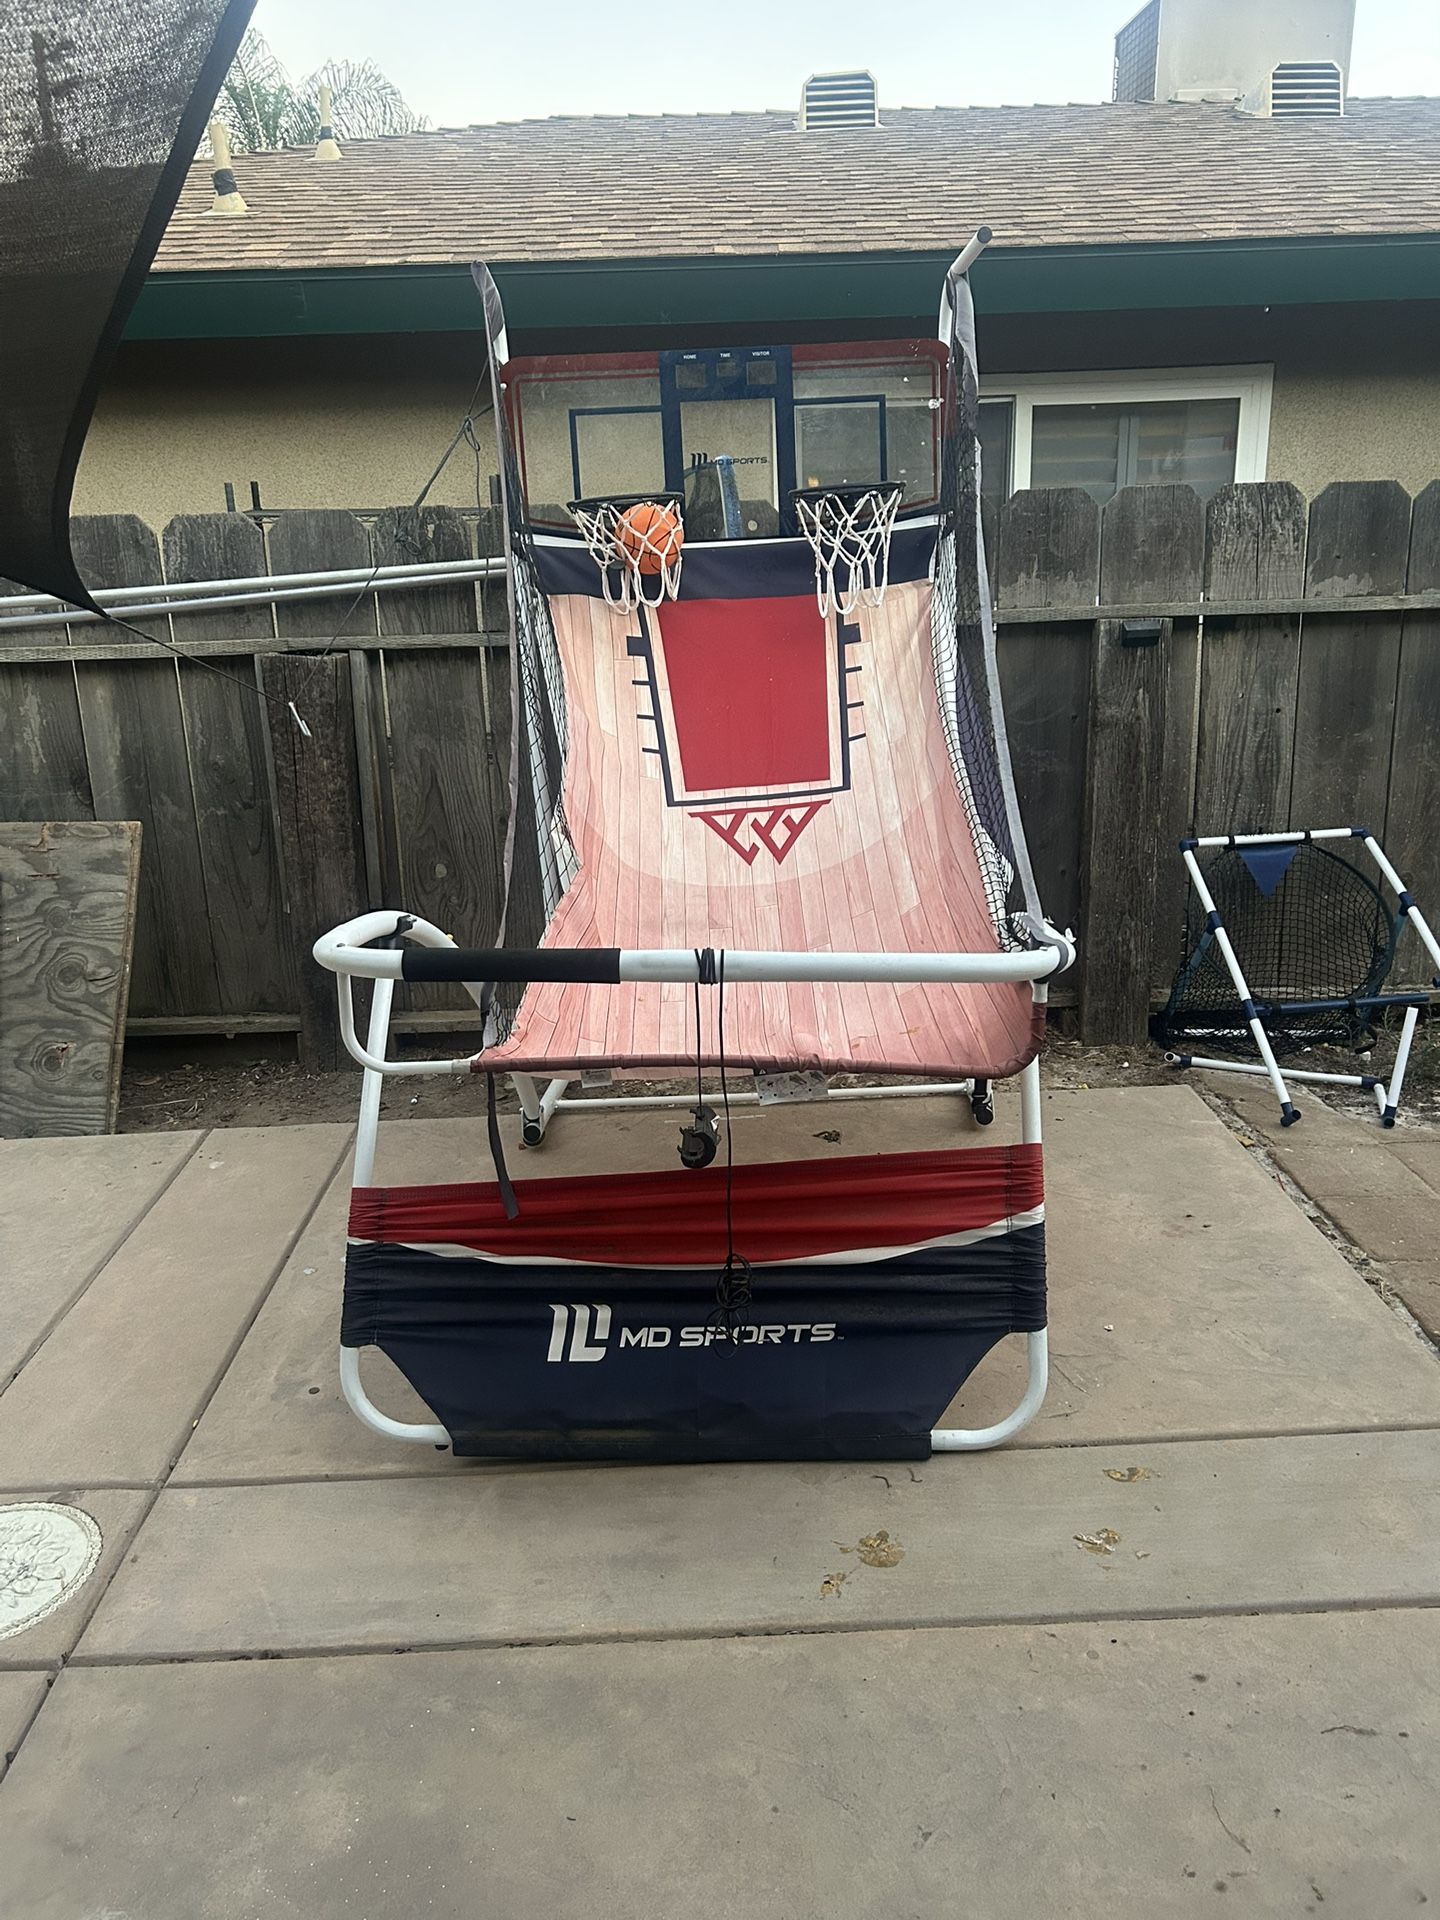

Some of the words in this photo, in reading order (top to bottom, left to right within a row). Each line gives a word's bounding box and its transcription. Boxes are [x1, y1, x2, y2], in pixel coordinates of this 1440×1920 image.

[726, 456, 768, 466] SPORTS
[619, 1326, 672, 1348] MD
[679, 1323, 837, 1347] SPORTS
